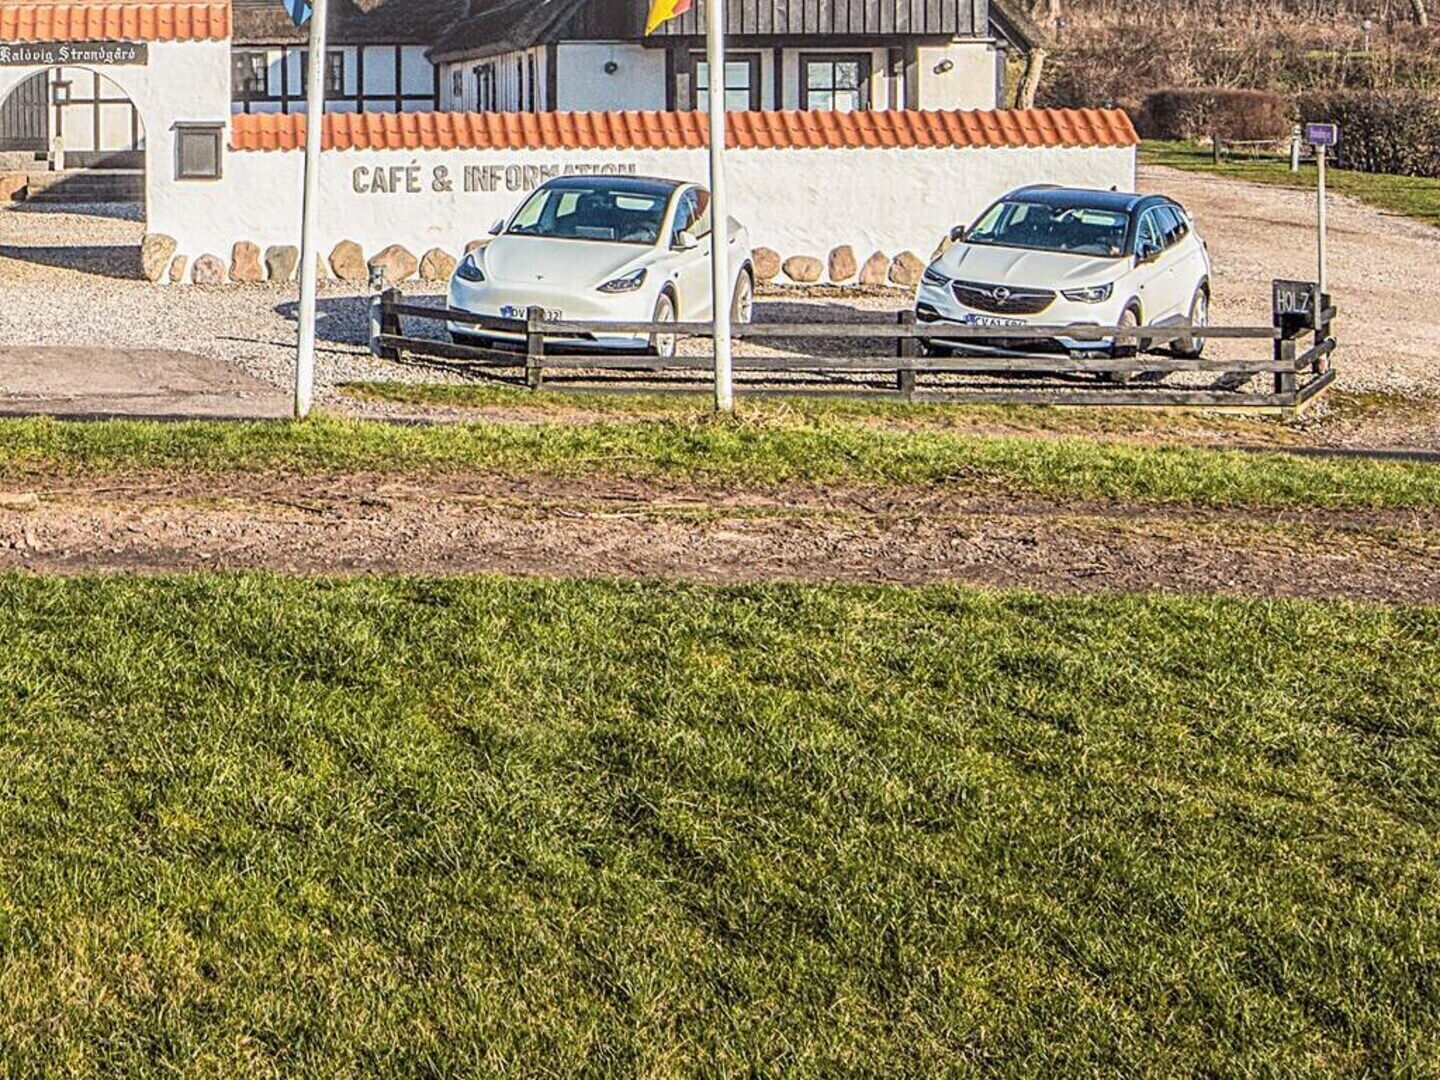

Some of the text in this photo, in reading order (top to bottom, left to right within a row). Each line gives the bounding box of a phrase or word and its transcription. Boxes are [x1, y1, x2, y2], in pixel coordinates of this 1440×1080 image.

[352, 159, 422, 193] CAFÉ
[431, 165, 453, 192] &
[1276, 290, 1309, 313] HOLZ
